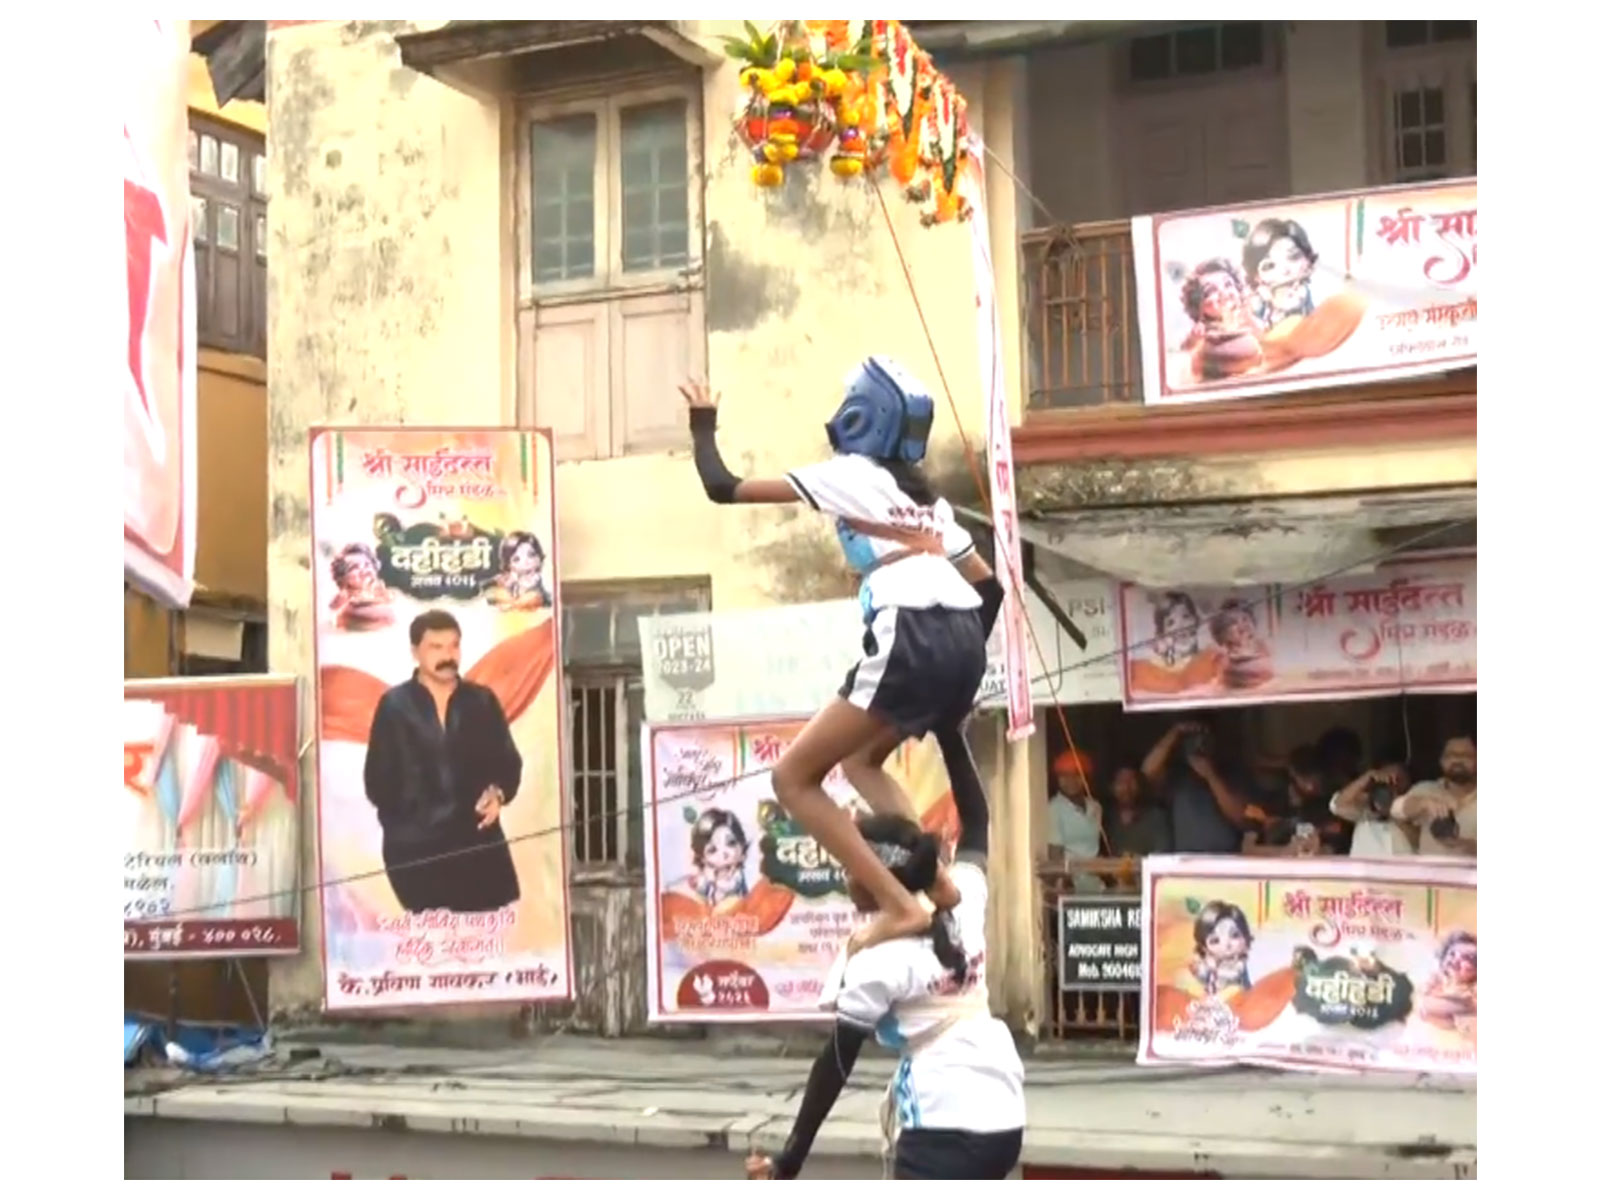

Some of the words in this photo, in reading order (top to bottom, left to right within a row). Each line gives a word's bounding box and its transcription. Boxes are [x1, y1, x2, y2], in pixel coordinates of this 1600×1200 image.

[1376, 207, 1425, 246] श्री
[362, 447, 392, 475] श्री
[402, 447, 493, 484] साईदत्त
[390, 536, 493, 575] दहीहंडी
[1297, 585, 1337, 618] श्री
[656, 634, 711, 660] OPEN
[753, 733, 781, 763] श्री
[1066, 907, 1122, 929] SAMIKSHA
[1283, 889, 1311, 917] श्री
[1067, 943, 1112, 958] ADVOCATE
[1113, 943, 1139, 958] HIGH
[1305, 970, 1397, 1005] दहीहंडी
